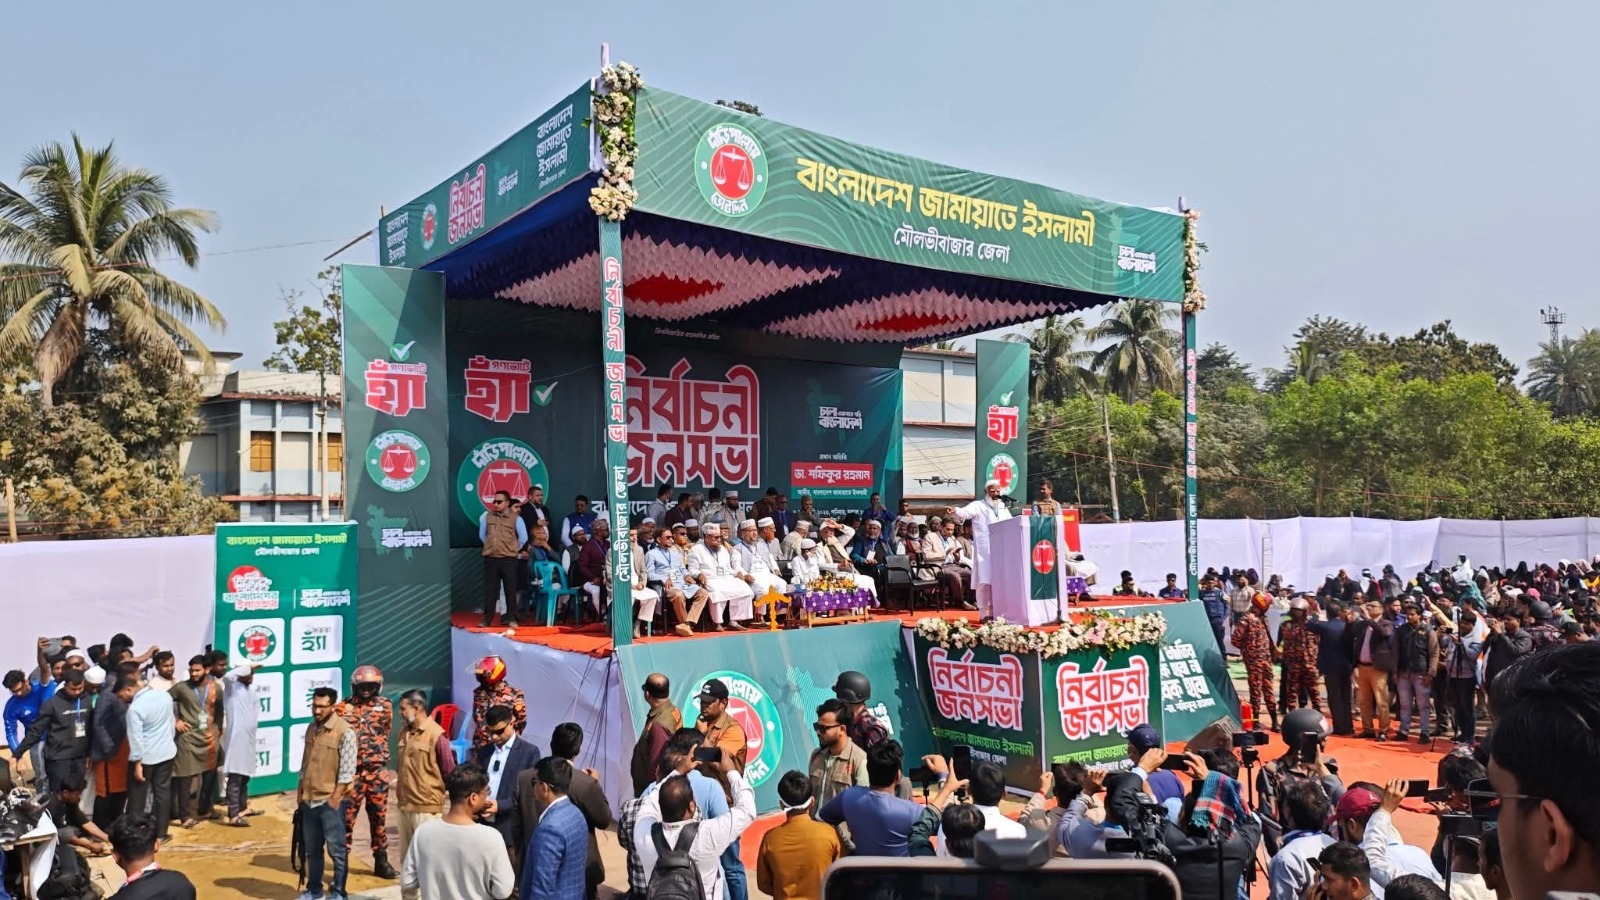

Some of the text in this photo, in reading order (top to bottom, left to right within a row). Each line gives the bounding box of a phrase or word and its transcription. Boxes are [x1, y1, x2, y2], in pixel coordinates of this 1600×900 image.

[537, 123, 572, 157] জামায়াতে
[538, 104, 573, 138] বাংলাদেশ
[539, 143, 568, 176] ইসলামী
[449, 163, 486, 220] নির্বাচনী
[797, 157, 1096, 247] বাংলাদেশ জামায়াতে ইসলামী
[448, 202, 485, 244] জনসভা
[894, 221, 1010, 264] মৌলভীবাজার জেলা
[604, 257, 623, 351] নির্বাচনী
[606, 362, 627, 443] জনসভা
[819, 416, 863, 429] বাংলাদেশ
[613, 465, 627, 498] জেলা
[794, 465, 870, 484] ডা. শফিকুর রহমান
[613, 503, 631, 582] মৌলভীবাজার
[927, 647, 1023, 702] নির্বাচনী
[1056, 654, 1150, 711] নির্বাচনী
[934, 688, 1023, 731] জনসভা
[1061, 697, 1149, 741] জনসভা
[967, 733, 1001, 750] জামায়াতে
[1002, 738, 1035, 757] ইসলামী
